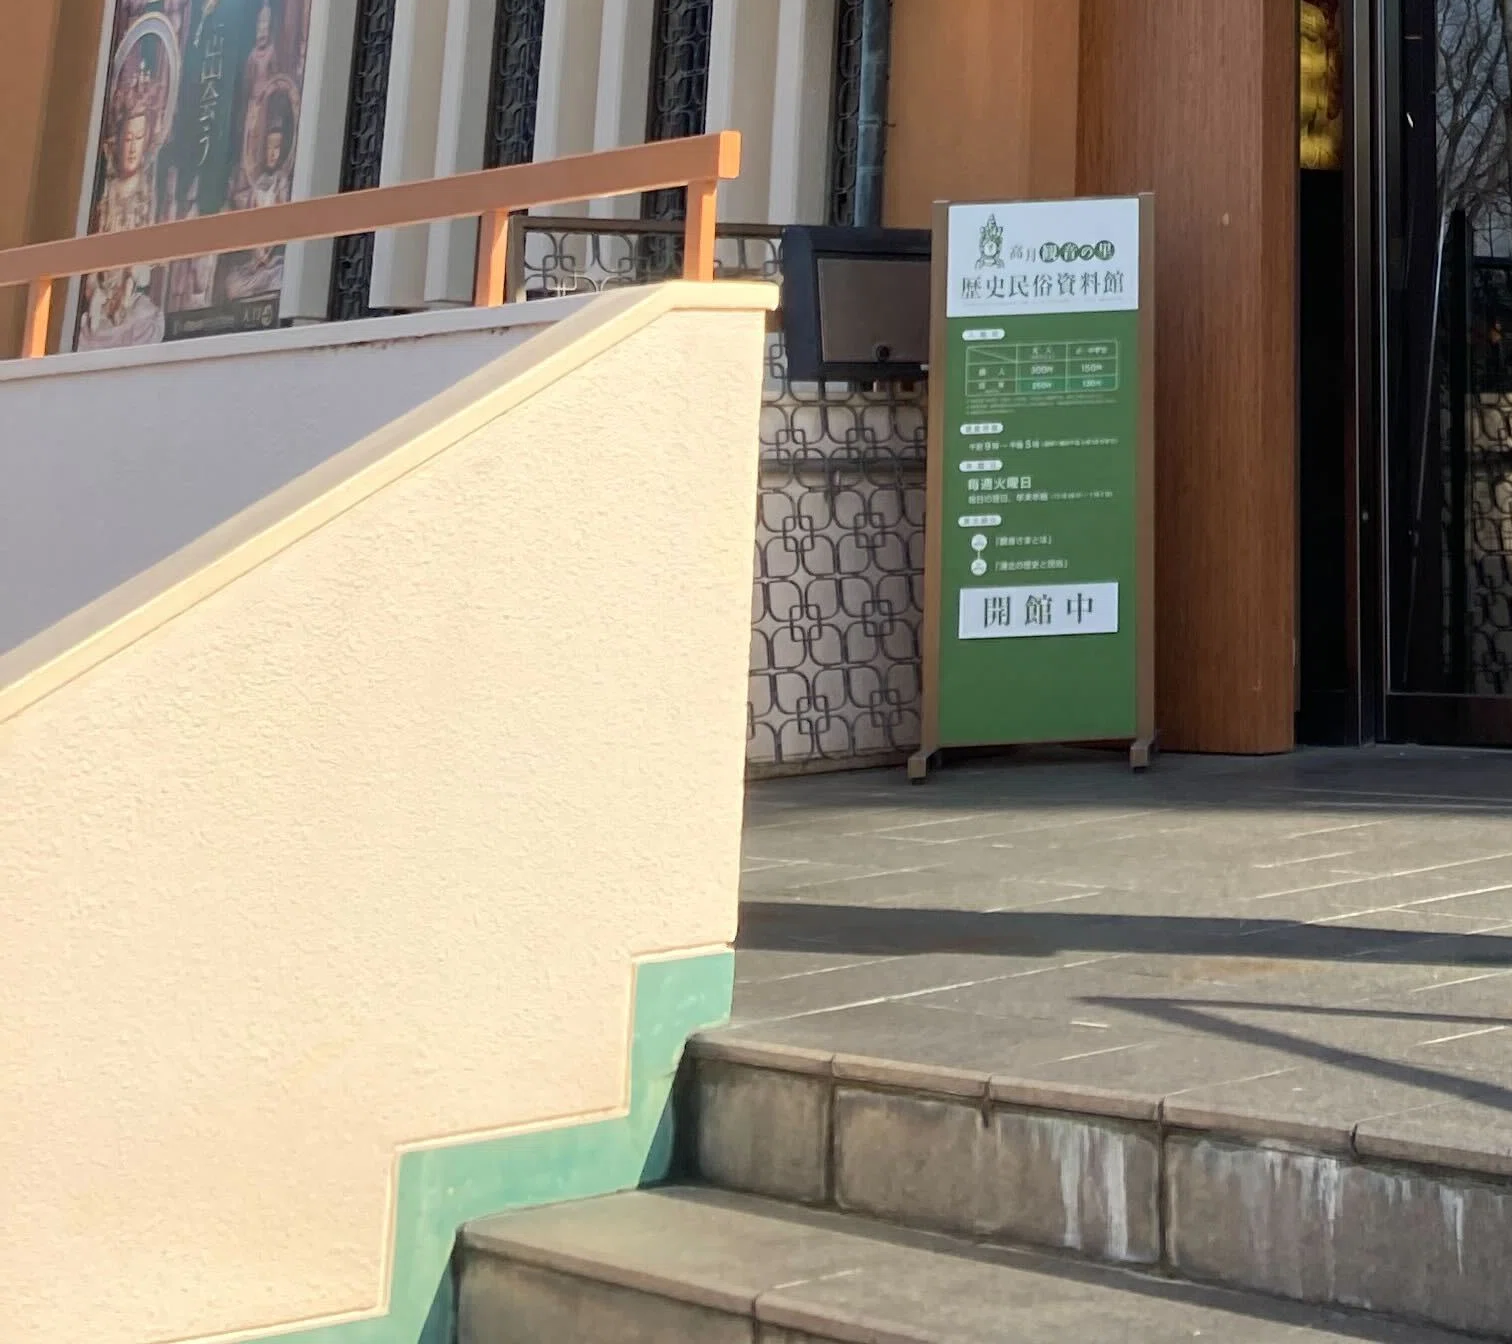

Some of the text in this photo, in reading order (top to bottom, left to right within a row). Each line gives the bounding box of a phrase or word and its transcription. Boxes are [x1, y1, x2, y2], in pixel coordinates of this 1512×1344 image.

[961, 269, 1125, 300] 歴史民俗資料館
[984, 593, 1094, 629] 開館中
